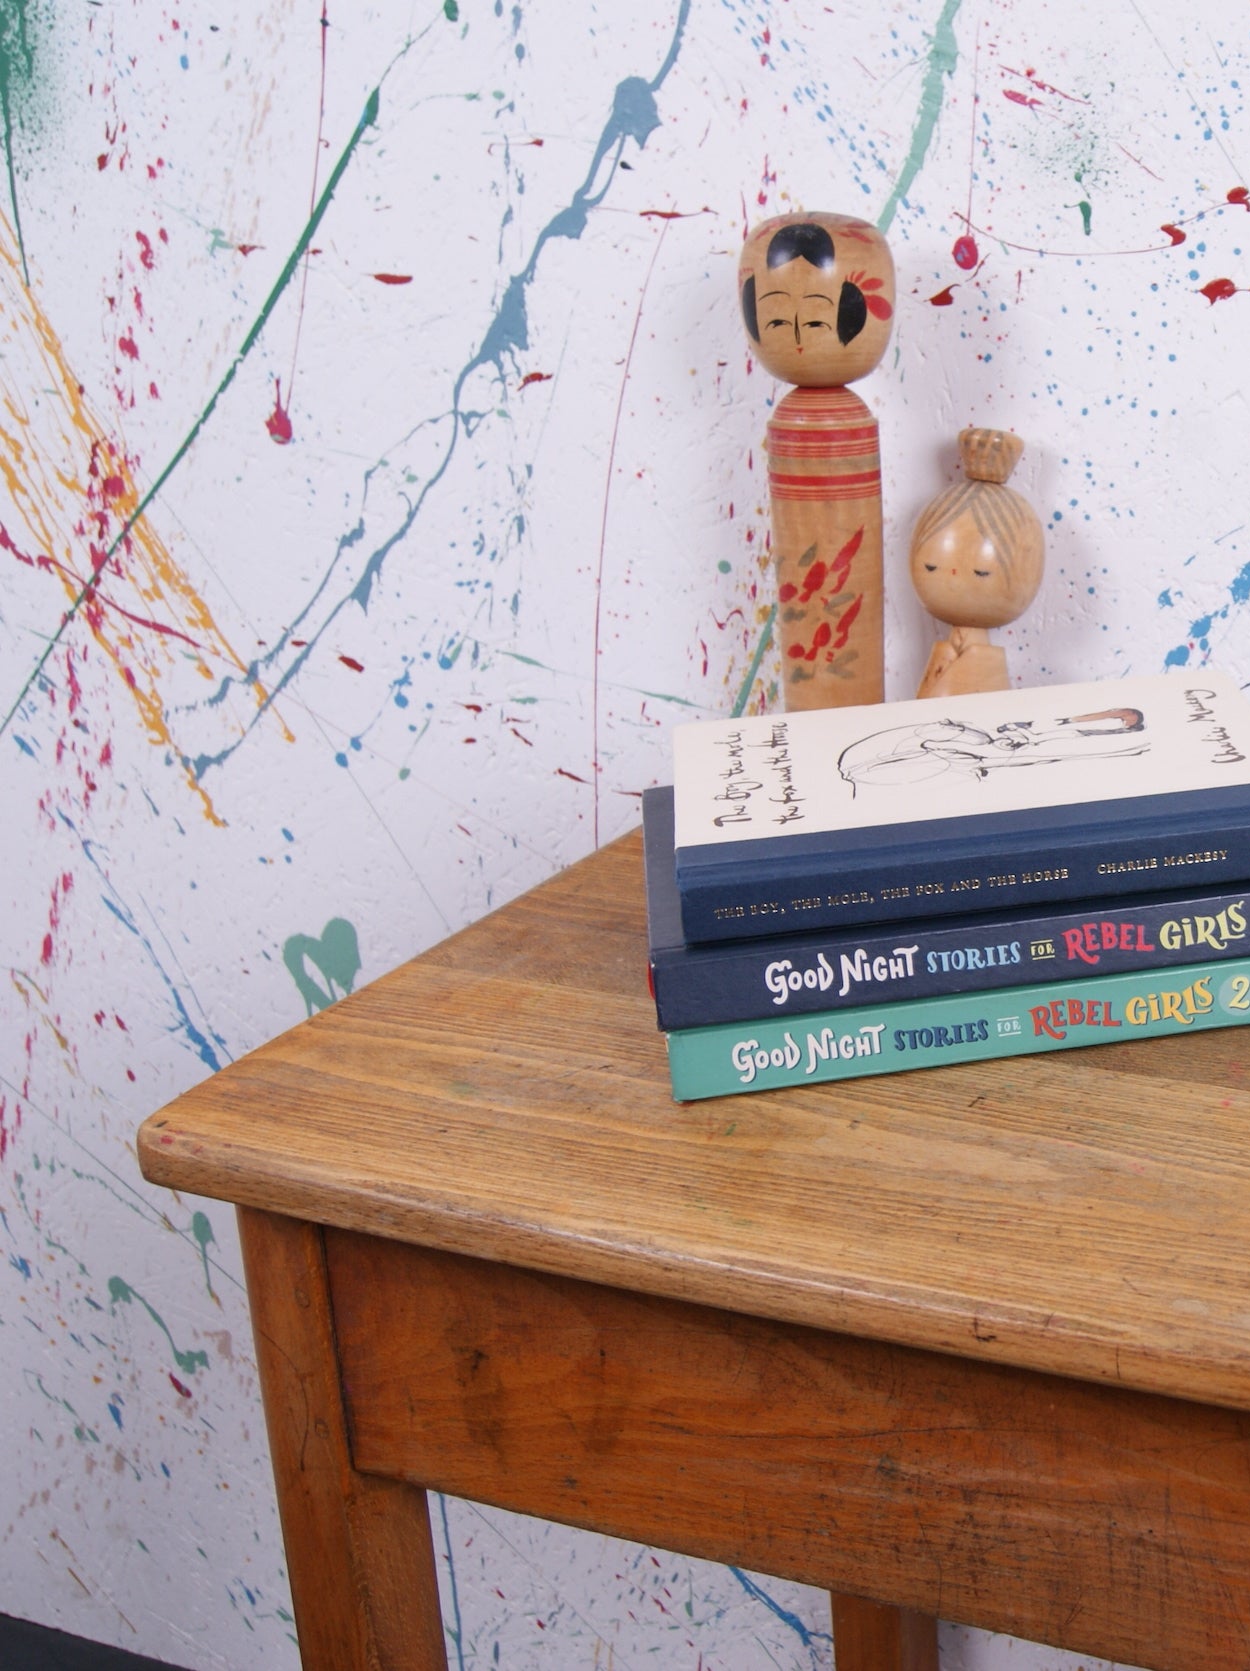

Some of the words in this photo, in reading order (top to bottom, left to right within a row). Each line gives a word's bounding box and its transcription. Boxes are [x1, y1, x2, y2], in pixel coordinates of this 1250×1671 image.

[762, 748, 792, 766] the
[1200, 726, 1246, 764] Charlie
[771, 765, 792, 782] and
[768, 785, 808, 804] fox
[714, 804, 752, 828] The
[771, 806, 806, 825] the
[1097, 858, 1158, 875] CHARLIE
[1164, 850, 1229, 867] MACKESY
[714, 906, 745, 920] THE
[792, 898, 822, 911] THE
[828, 891, 874, 906] MOLE,
[880, 887, 910, 900] THE
[915, 882, 945, 896] FOX
[950, 878, 981, 892] AND
[987, 874, 1017, 888] THE
[1022, 868, 1070, 884] HORSE
[926, 941, 1021, 974] STORIES
[1030, 942, 1056, 958] FOR
[1062, 921, 1156, 966] REBEL
[1158, 900, 1248, 951] GIRLS
[894, 1018, 990, 1051] STORIES
[997, 1021, 1022, 1032] FOR
[1028, 998, 1122, 1040] REBEL
[1124, 976, 1215, 1026] GIRLS
[1229, 976, 1250, 1010] 2
